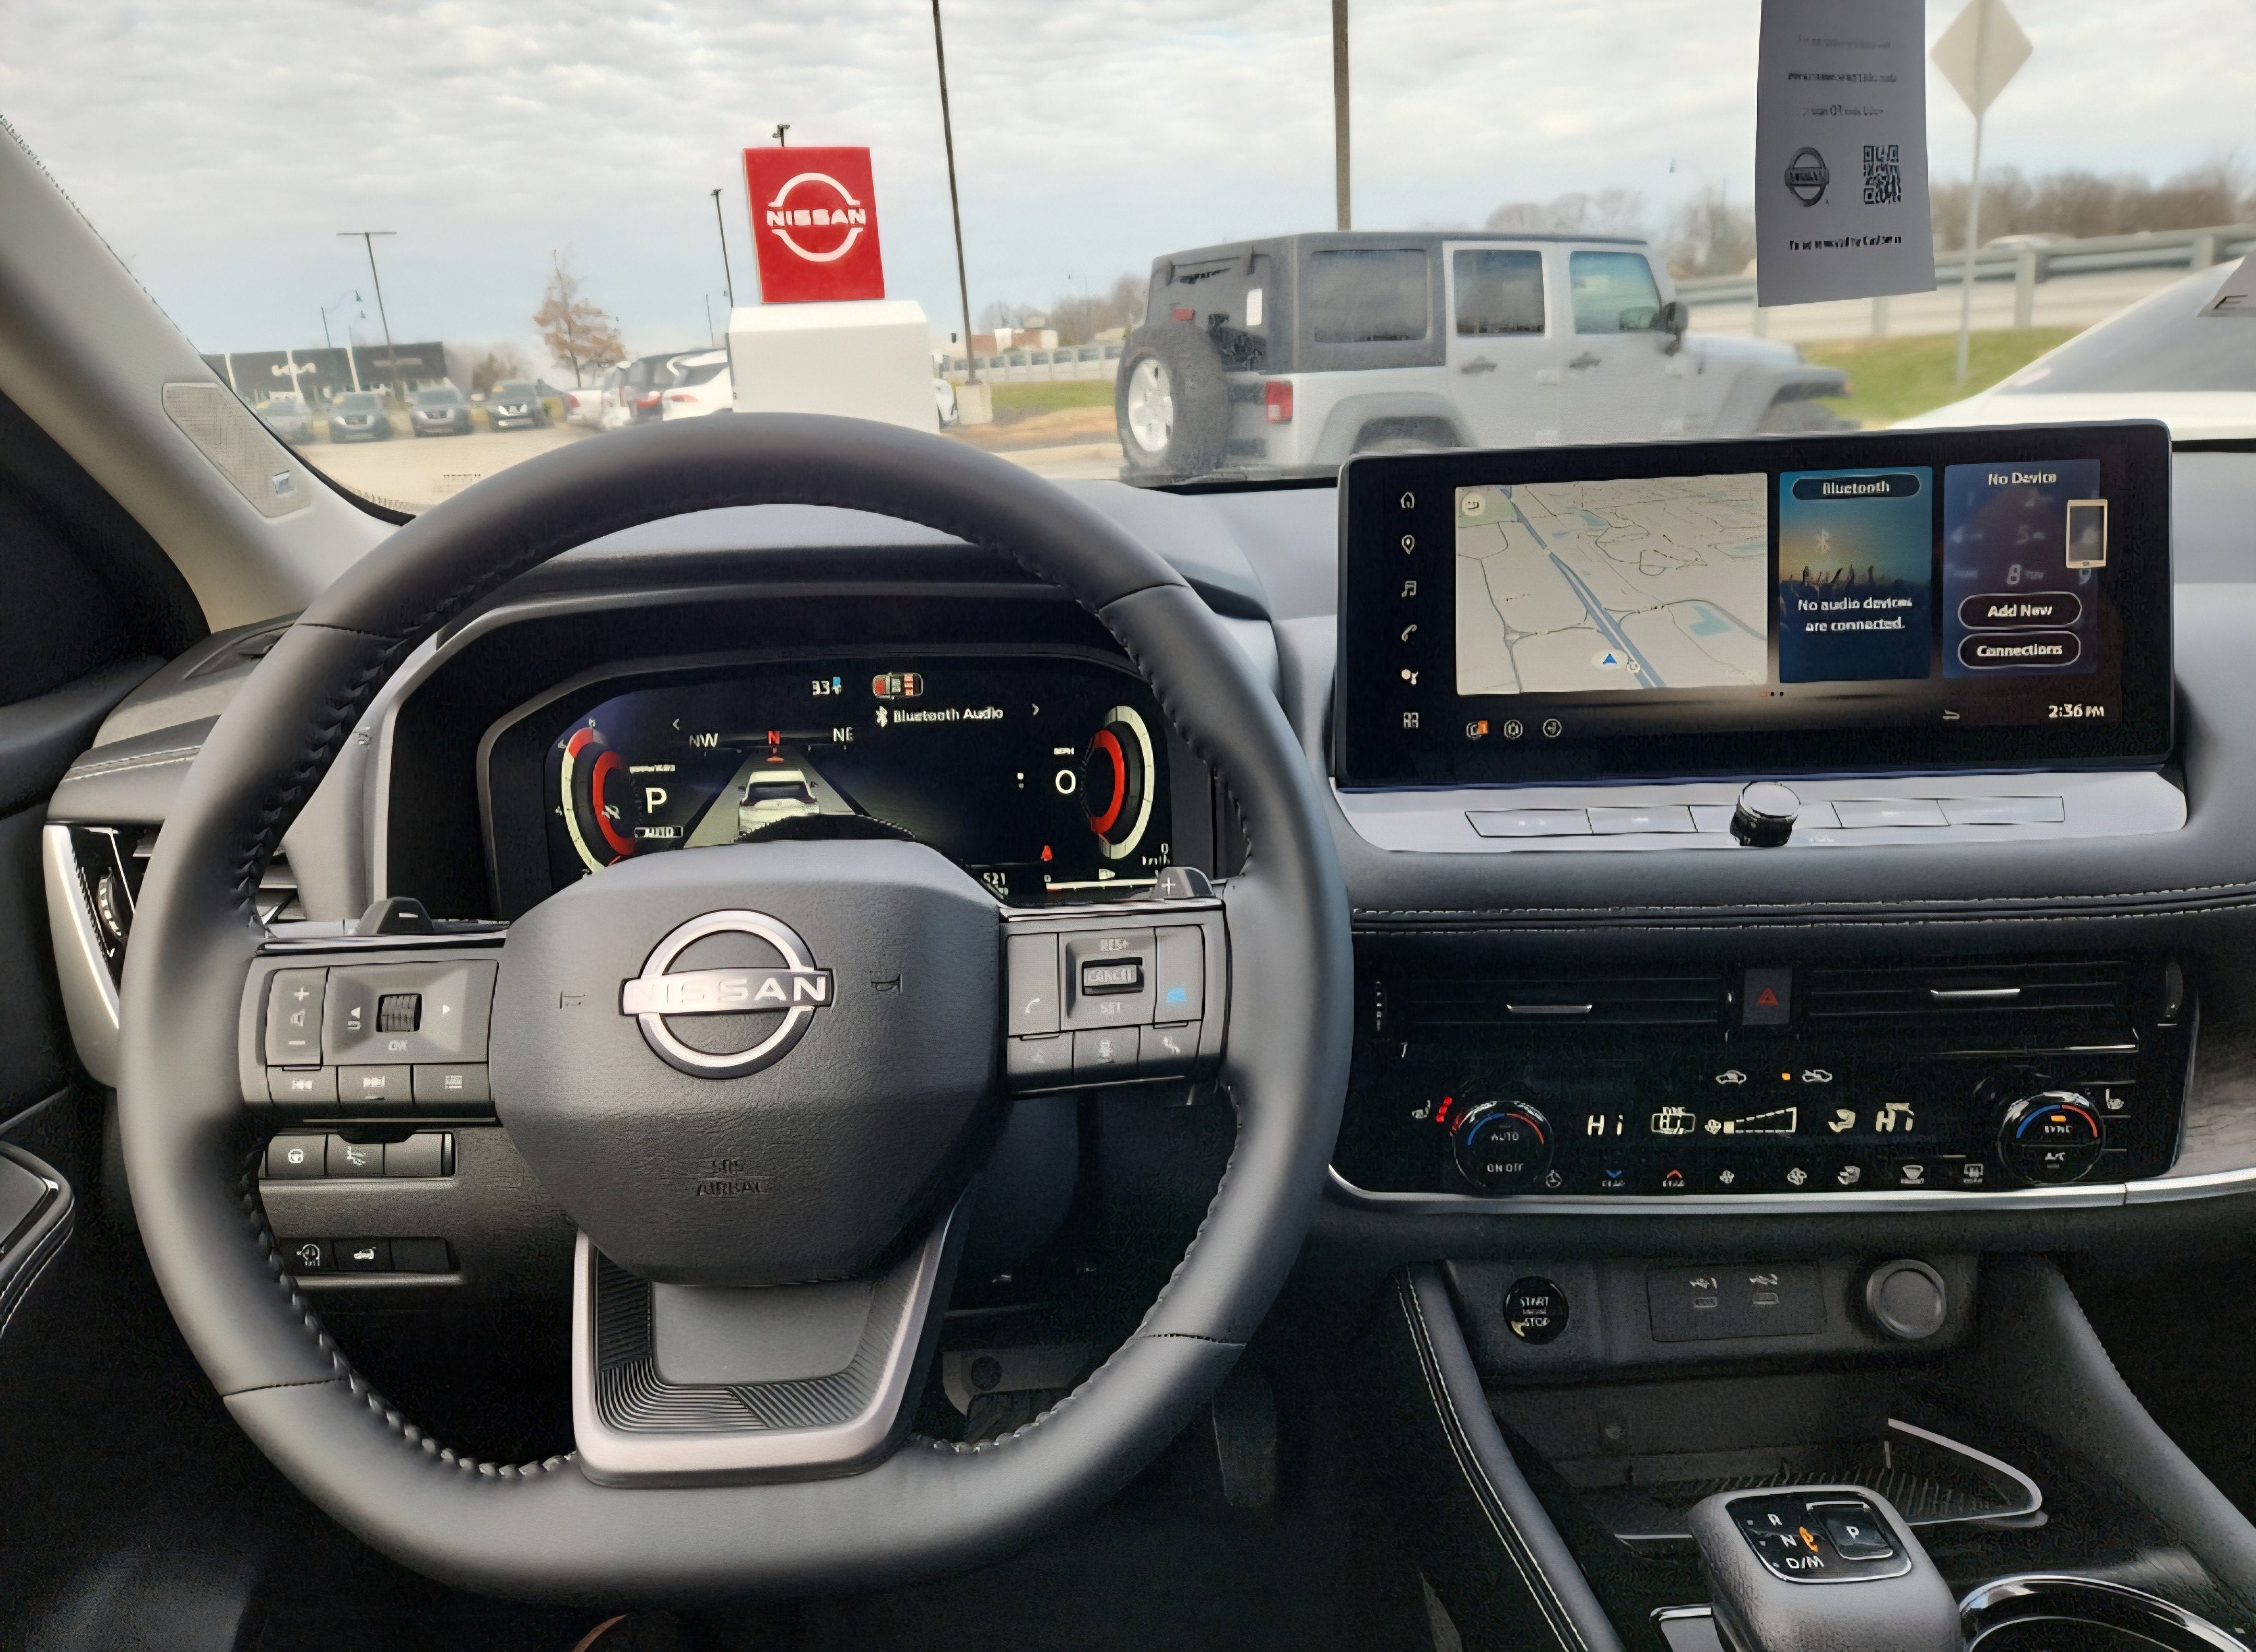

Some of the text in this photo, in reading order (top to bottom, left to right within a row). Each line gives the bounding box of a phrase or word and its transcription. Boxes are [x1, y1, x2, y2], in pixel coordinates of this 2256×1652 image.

[767, 208, 866, 227] NISSAN
[1988, 473, 2008, 486] No
[1798, 599, 1818, 611] No
[1821, 597, 1860, 611] audio
[1987, 604, 2053, 617] Add New
[1805, 622, 1827, 632] are
[1977, 643, 2063, 657] Connections
[893, 705, 1004, 723] Bluetooth Audio
[2048, 704, 2083, 718] 2:36
[689, 733, 718, 748] NW
[768, 730, 780, 744] N
[832, 727, 854, 742] NE
[1055, 770, 1076, 794] 0
[645, 787, 667, 814] P
[1780, 1534, 1797, 1547] N
